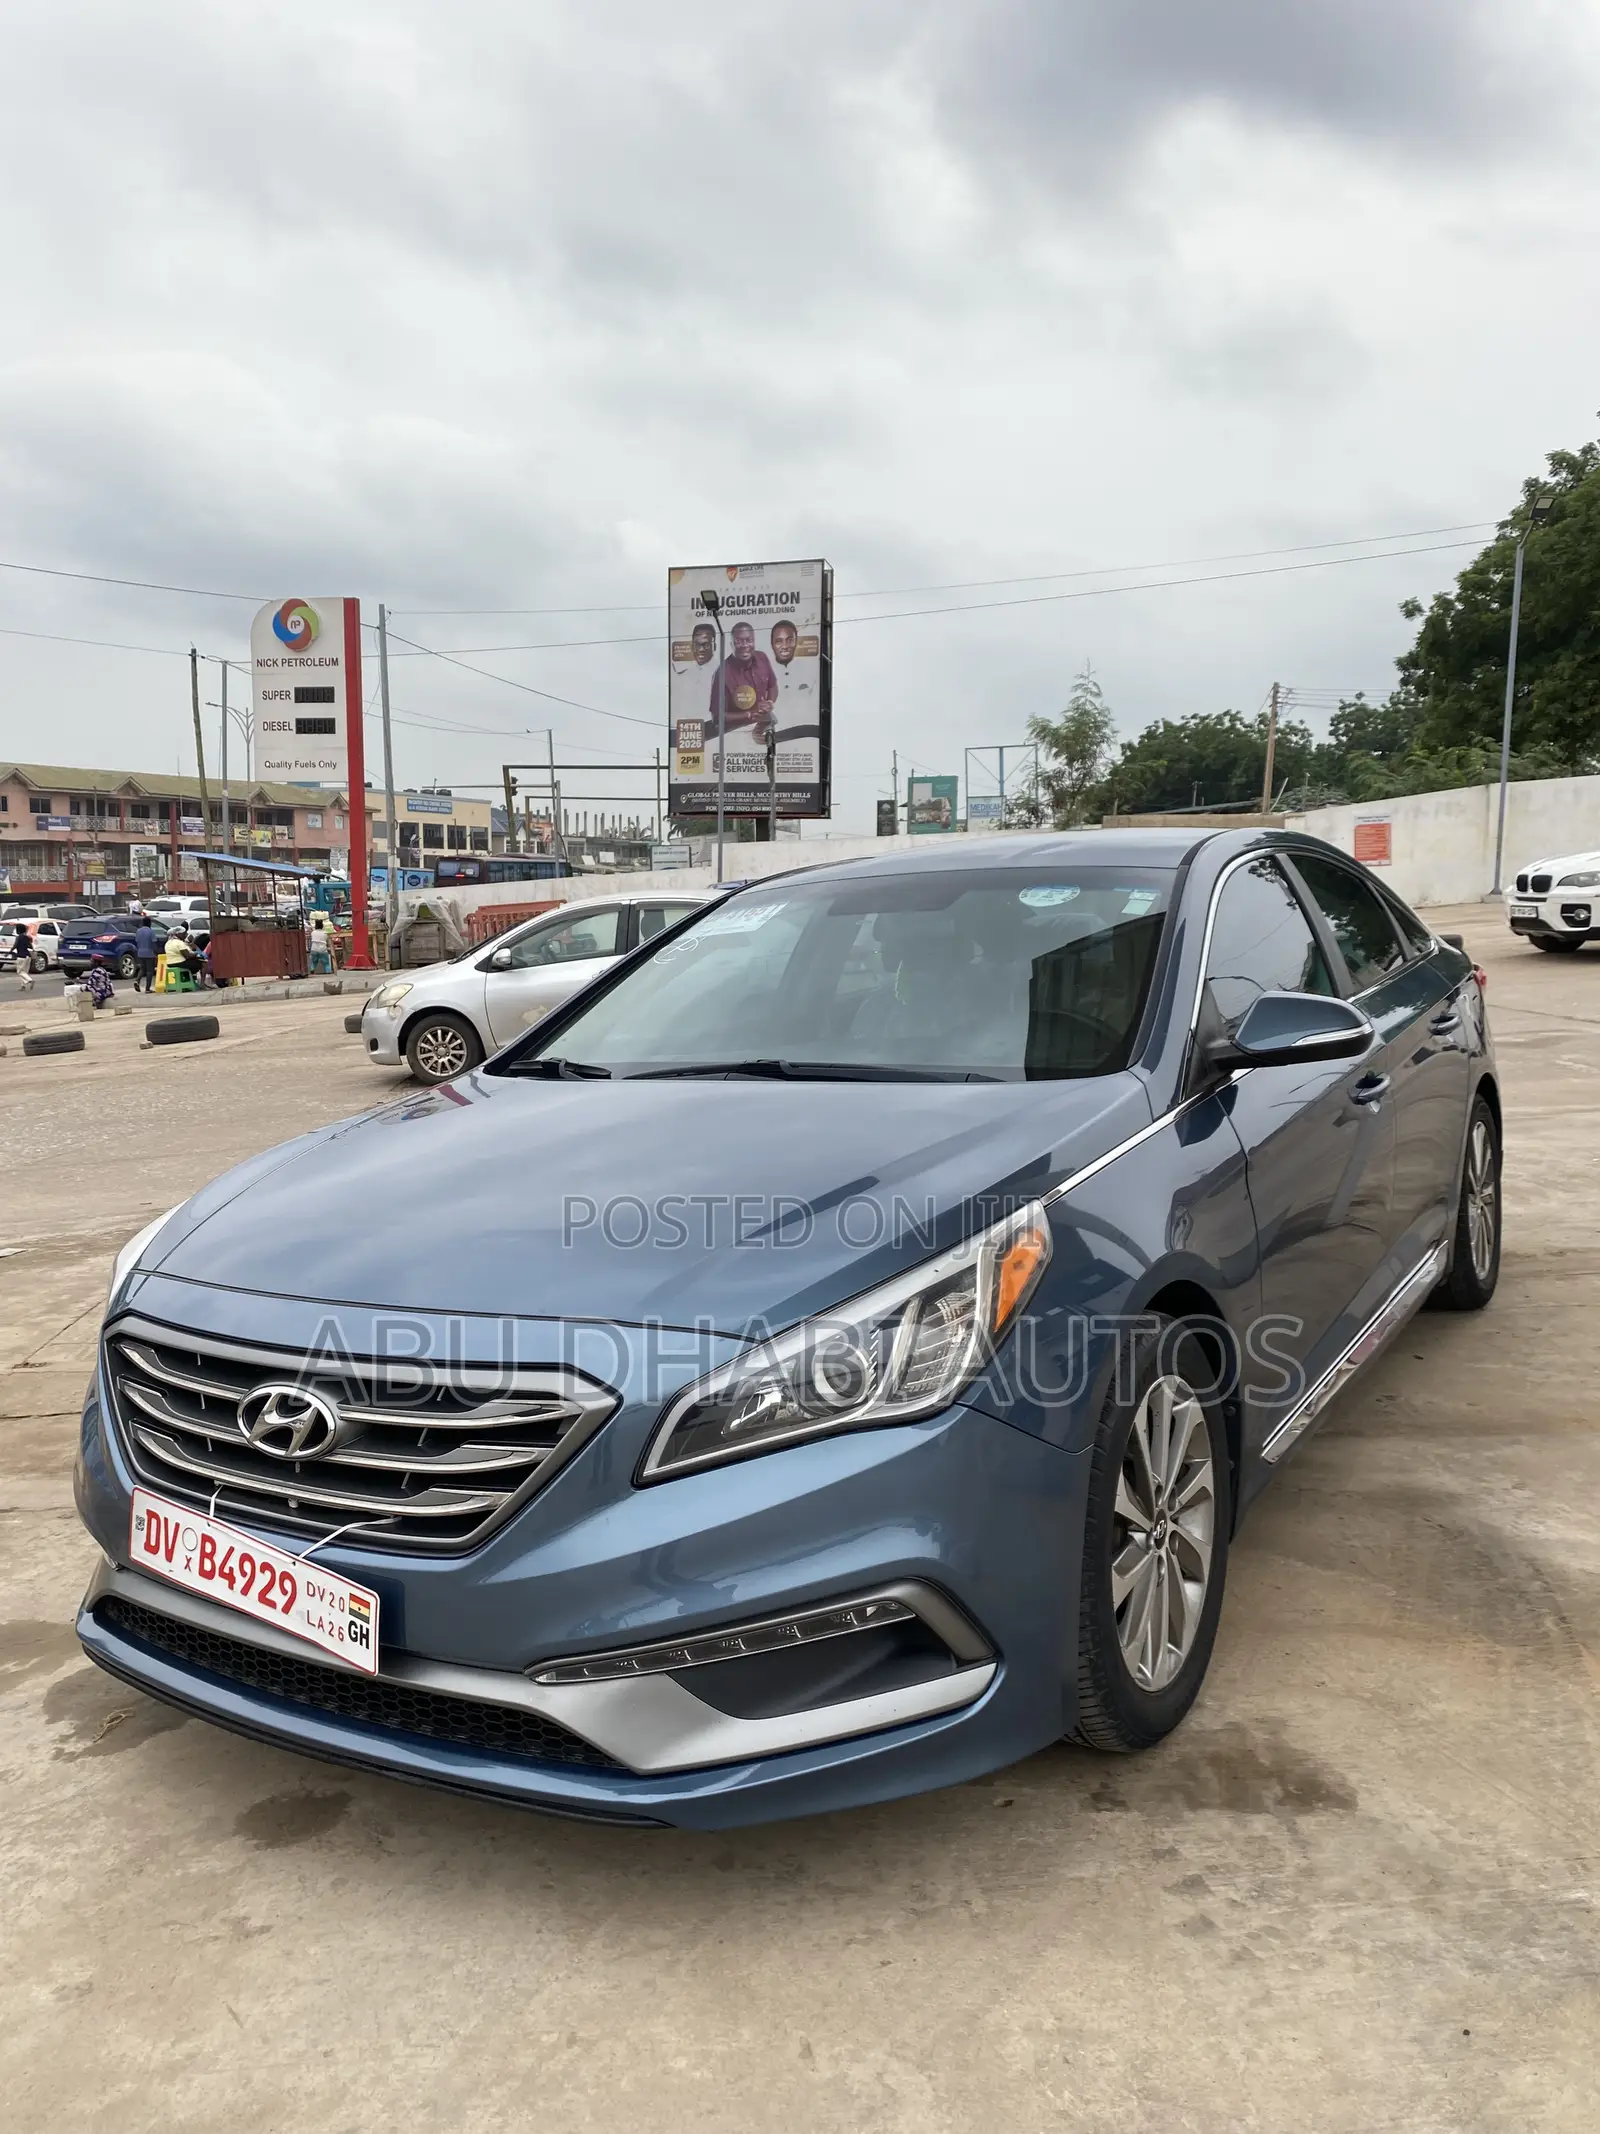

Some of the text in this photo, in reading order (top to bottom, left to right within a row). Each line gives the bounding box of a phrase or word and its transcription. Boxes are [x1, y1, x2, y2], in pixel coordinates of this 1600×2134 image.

[691, 591, 800, 610] INUGURATION
[725, 608, 757, 616] CHURCH
[758, 606, 796, 614] BUILDING
[256, 657, 339, 667] NICK PETROLEUM
[262, 690, 292, 700] SUPER
[262, 721, 293, 731] DIESEL
[680, 723, 701, 731] 14TH
[679, 731, 702, 740] JUNE
[680, 740, 701, 748] 2026
[264, 759, 338, 770] Quality Fuels Only
[680, 756, 700, 764] 2PM
[144, 1508, 180, 1563] DV
[198, 1533, 298, 1615] B4929
[347, 1620, 370, 1650] GH
